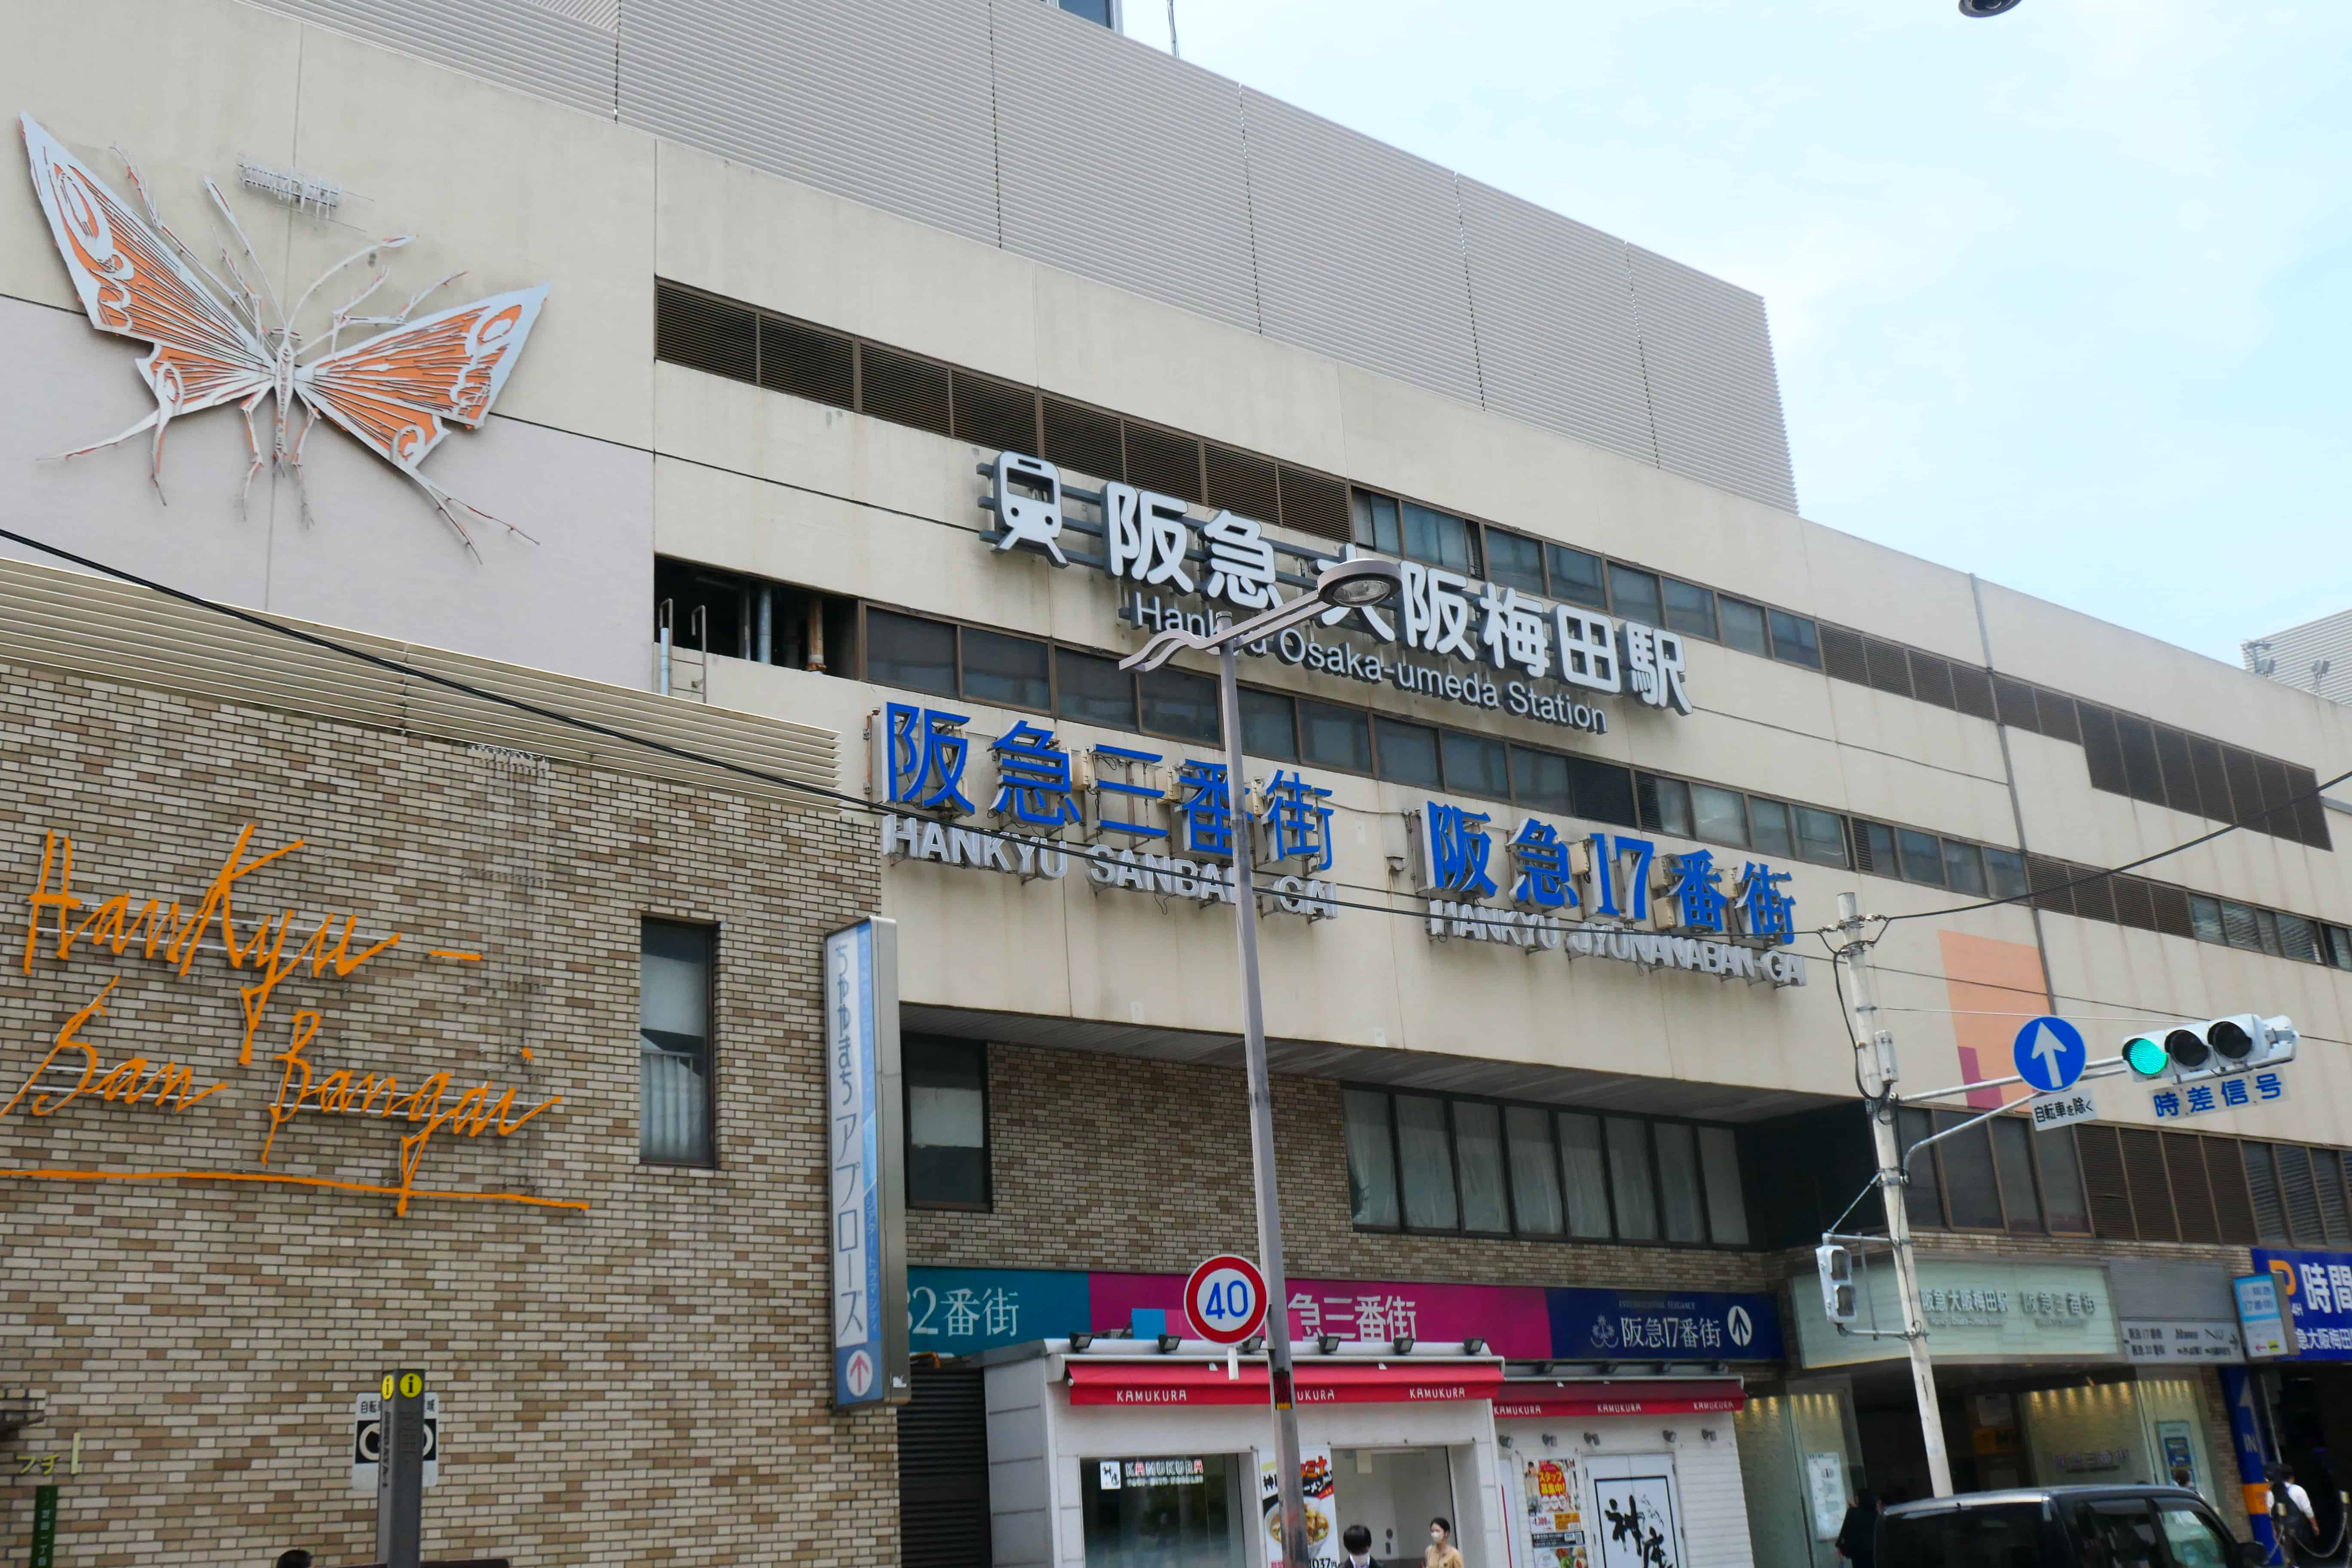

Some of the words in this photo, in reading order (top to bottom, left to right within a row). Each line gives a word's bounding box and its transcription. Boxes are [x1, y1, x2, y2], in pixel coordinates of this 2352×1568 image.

[1134, 591, 1268, 655] Hanku
[1279, 627, 1499, 708] Osaka-umeda
[1507, 680, 1607, 735] Station
[881, 702, 1334, 870] 阪急三番街
[883, 814, 1068, 880] HANKYU
[1422, 800, 1796, 946] 阪急17番街
[1429, 900, 1561, 949] HANKYU
[2034, 1098, 2094, 1123] 自転車を除く
[2153, 1073, 2282, 1118] 時差信号
[1206, 1280, 1248, 1320] 40
[2300, 1262, 2352, 1314] 時間
[1288, 1293, 1417, 1342] 急三番街
[1620, 1317, 1721, 1348] 阪急17番街
[1117, 1390, 1187, 1402] KAMUKURA
[1297, 1389, 1334, 1400] UKURA
[1409, 1387, 1465, 1400] KAMUKURA
[1494, 1406, 1541, 1415] KAMUKURA
[1597, 1403, 1642, 1413] KAMUKURA
[1693, 1400, 1734, 1411] KAMUKURA
[1125, 1459, 1204, 1477] KAMUKURA
